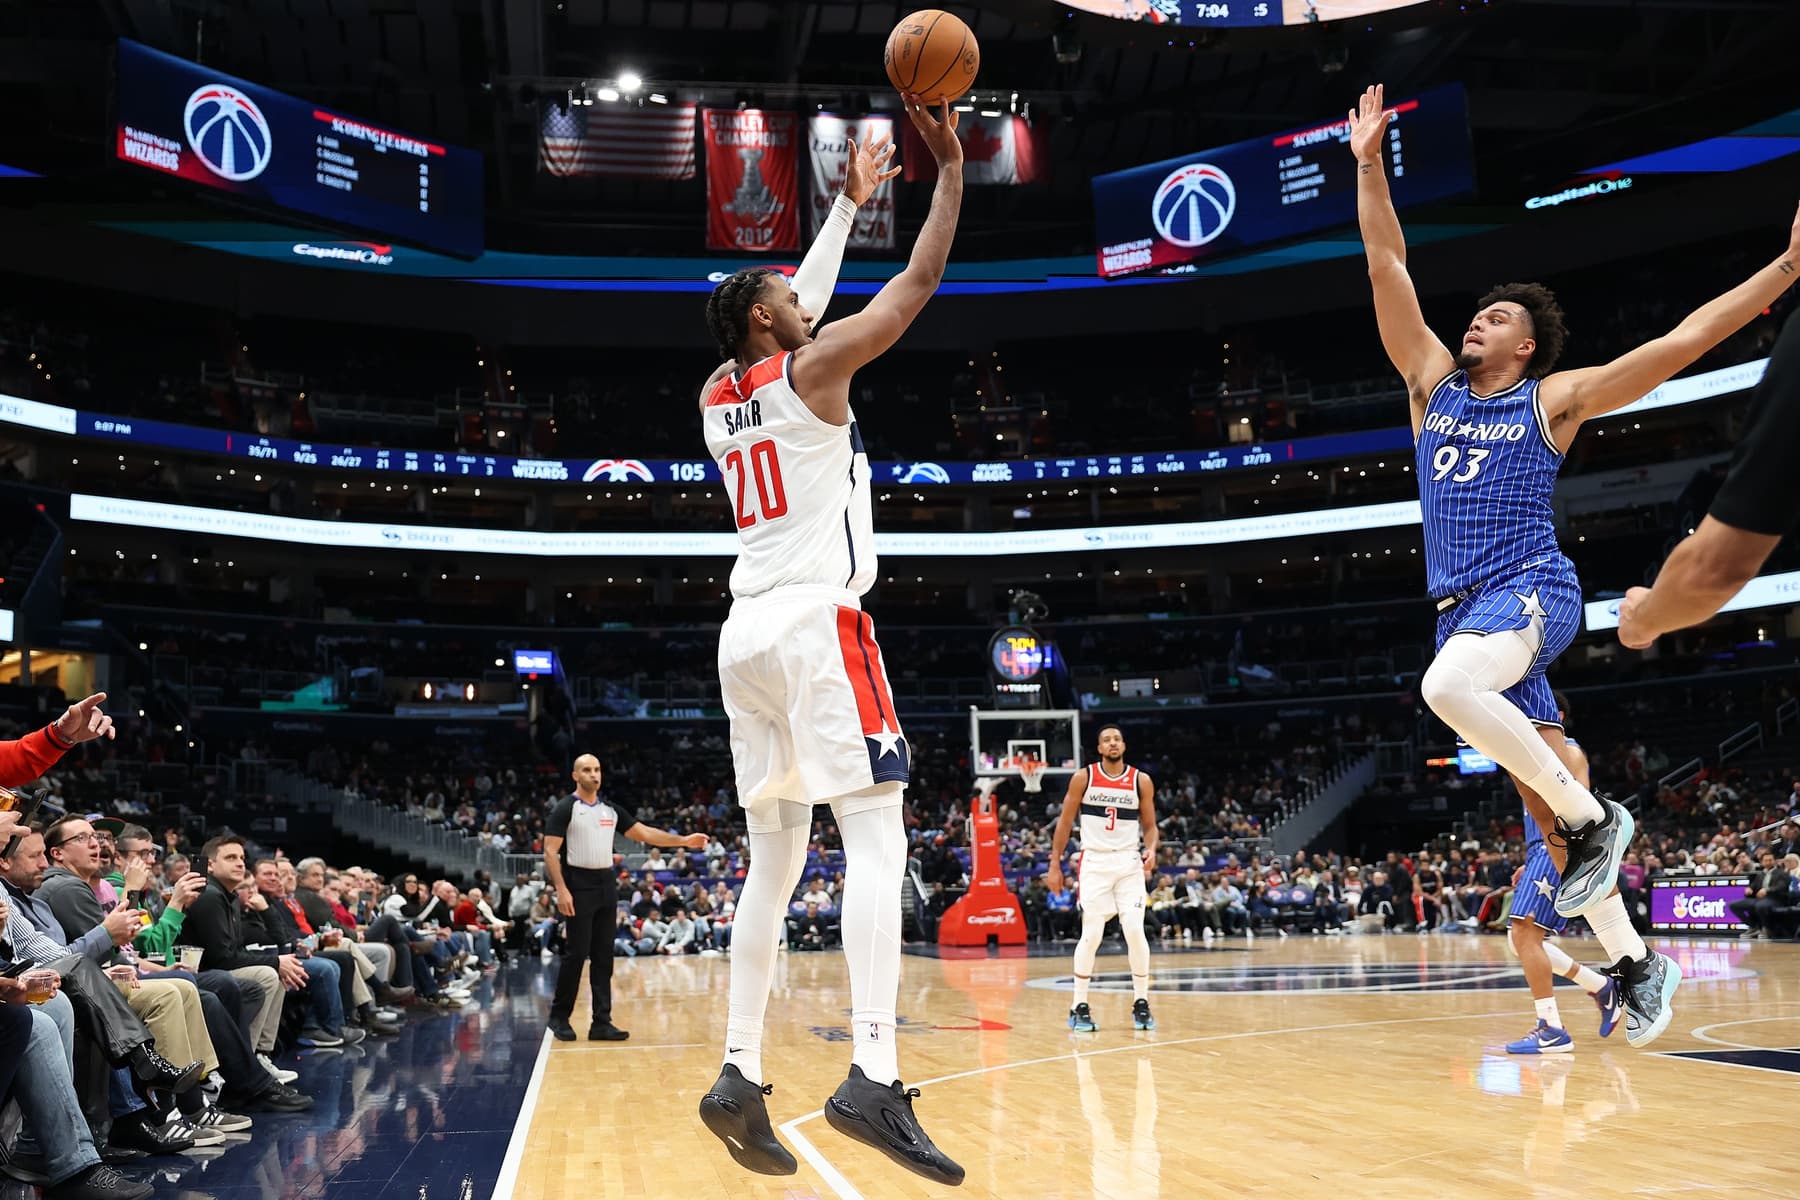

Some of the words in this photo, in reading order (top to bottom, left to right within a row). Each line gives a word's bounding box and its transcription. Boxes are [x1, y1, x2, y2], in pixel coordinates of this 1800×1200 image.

[1196, 3, 1229, 18] 7:04
[1253, 3, 1268, 17] :5
[710, 114, 764, 130] STANLEY
[768, 115, 792, 130] CUP
[715, 131, 789, 148] CHAMPIONS
[124, 138, 180, 172] WIZARDS
[735, 227, 773, 246] 2018
[1102, 248, 1153, 273] WIZARDS
[376, 458, 389, 470] 21
[433, 462, 446, 473] 14
[512, 465, 569, 481] WIZARDS
[669, 463, 706, 482] 105
[1432, 445, 1491, 483] 93
[725, 438, 788, 530] 20
[1105, 806, 1117, 831] 3
[1687, 895, 1727, 918] Giant
